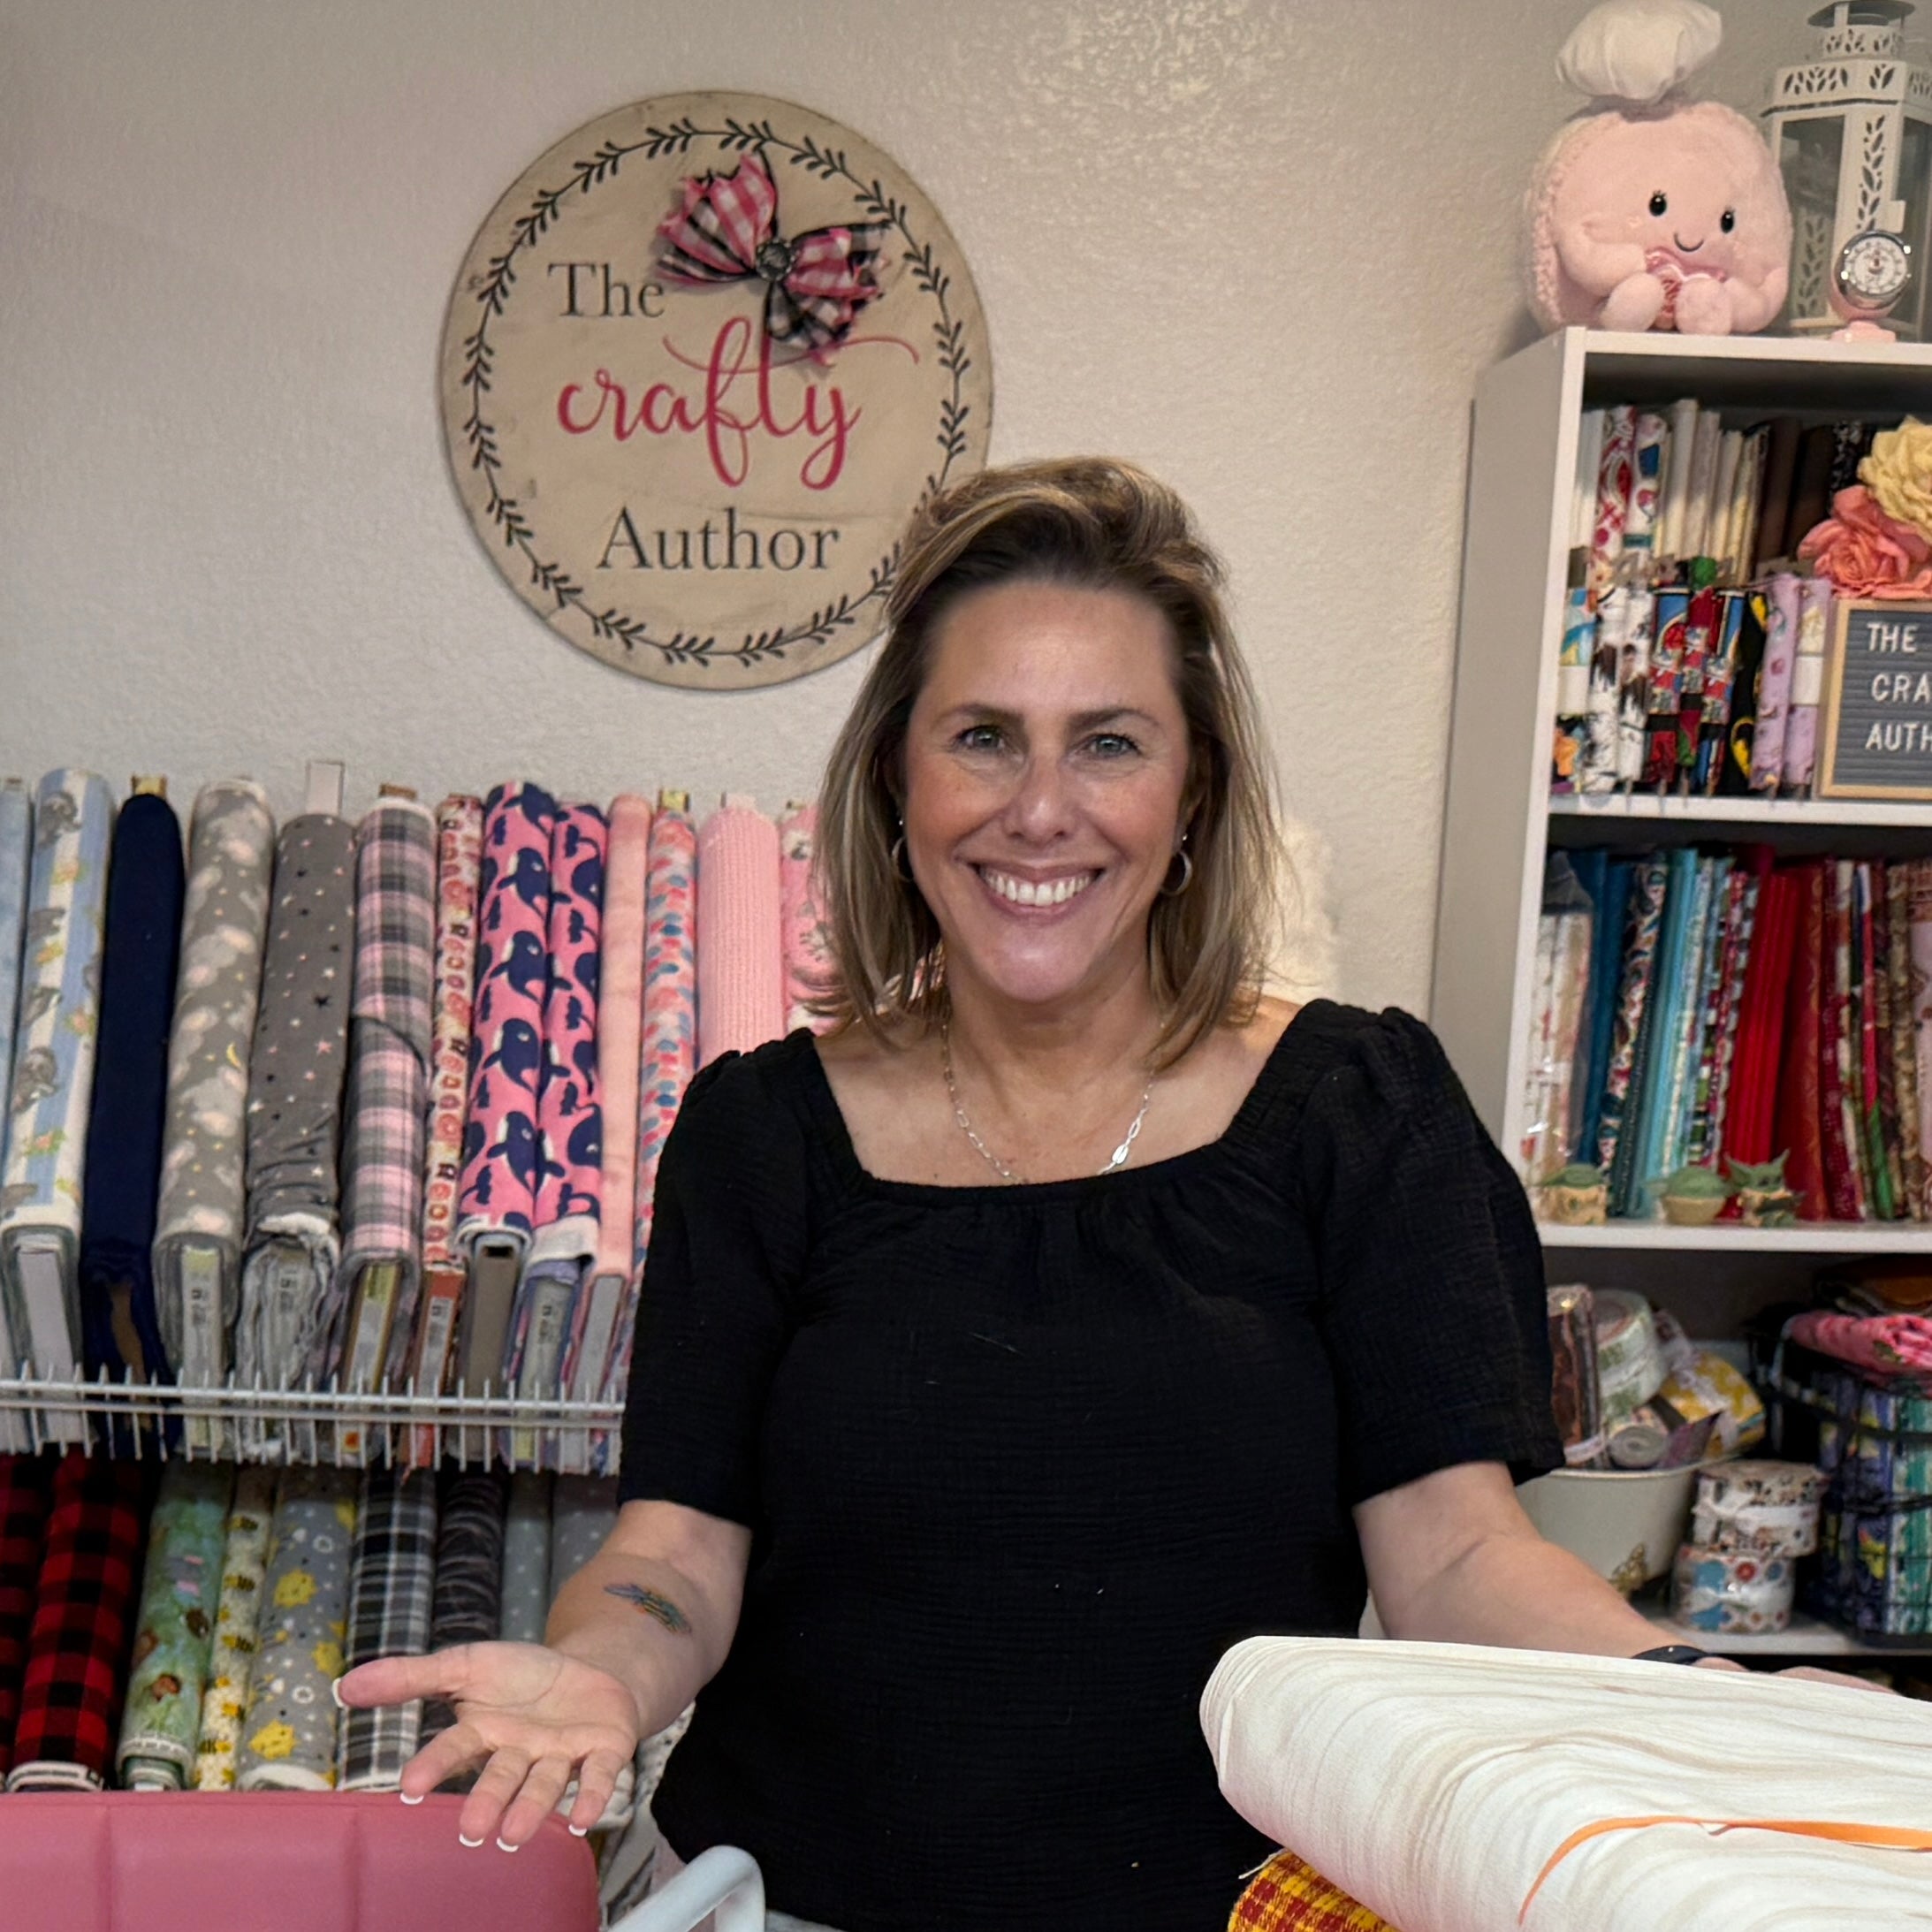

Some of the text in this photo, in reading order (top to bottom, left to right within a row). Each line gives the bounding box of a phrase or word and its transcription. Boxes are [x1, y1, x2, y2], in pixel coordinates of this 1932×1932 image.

[547, 262, 665, 318] The
[558, 316, 920, 491] crafty
[595, 506, 840, 572] Author
[1867, 621, 1920, 653] THE
[1871, 673, 1931, 704] CRA
